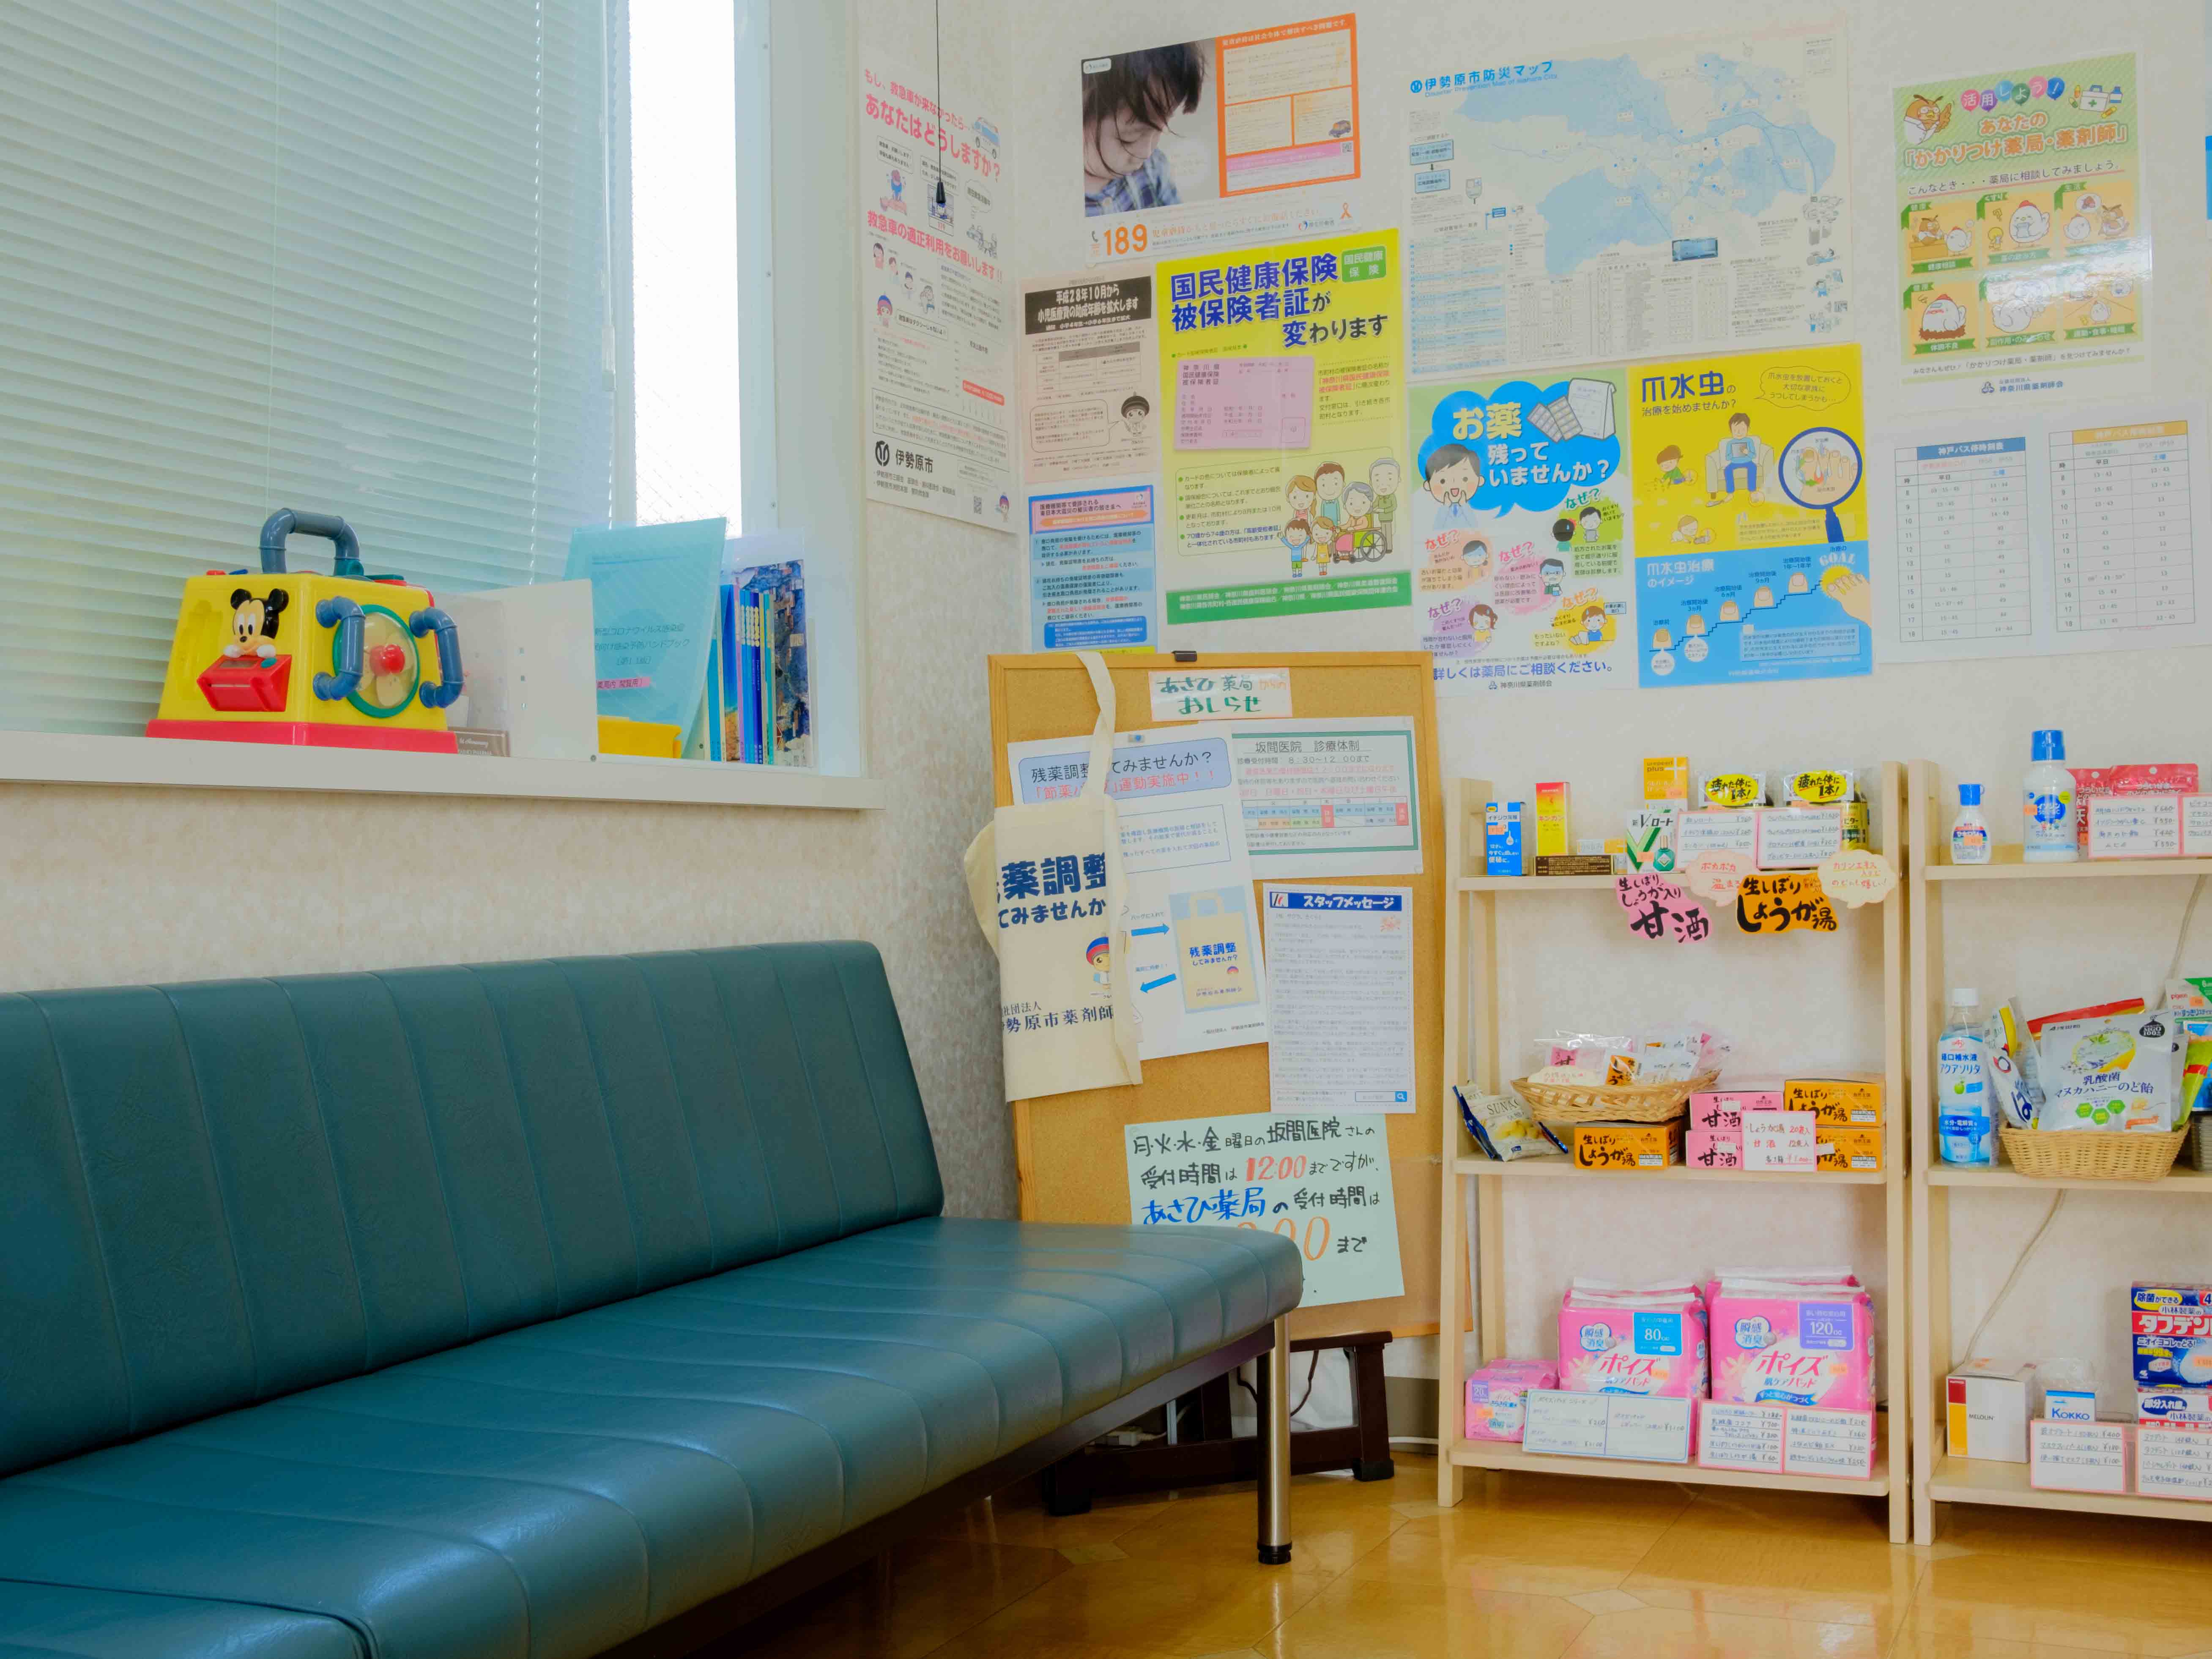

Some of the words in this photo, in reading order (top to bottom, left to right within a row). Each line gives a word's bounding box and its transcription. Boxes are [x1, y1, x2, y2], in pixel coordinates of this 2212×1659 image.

[1425, 60, 1553, 91] 伊勢原市防災マップ
[1980, 112, 2048, 135] あなたの
[1905, 123, 2127, 168] 「かかりつけ薬局・薬剤師」
[1104, 224, 1147, 256] 189
[1344, 250, 1383, 266] 国民健康
[1927, 261, 1956, 271] 健康相談
[1171, 252, 1339, 302] 国民健康保険
[1056, 284, 1120, 305] 平成28年10月から
[1172, 287, 1331, 332] 被保険者証が
[1283, 314, 1388, 348] 変わります
[1642, 370, 1736, 403] 爪水虫の
[1782, 383, 1826, 393] 大切な家族に
[1999, 381, 2064, 393] 神奈川県薬剤師会
[1642, 399, 1736, 417] 治療を始めませんか？
[1452, 401, 1522, 441] お薬
[896, 449, 933, 473] 伊勢原市
[1488, 442, 1549, 465] 残って
[1489, 460, 1610, 487] いませんか？
[1566, 488, 1599, 509] なぜ？
[1425, 529, 1459, 550] なぜ？
[1499, 541, 1533, 562] なぜ？
[1783, 556, 1812, 564] 治療開始後
[1819, 552, 1856, 567] GOAL
[1647, 559, 1715, 576] 爪水虫治療
[1748, 570, 1777, 579] 治療開始後
[1647, 575, 1695, 589] のイメージ
[1714, 584, 1743, 592] 治療開始後
[1428, 598, 1462, 619] なぜ？
[1562, 587, 1598, 610] なぜ？
[1433, 660, 1612, 681] 詳しくは薬局にご相談ください。
[1500, 680, 1552, 689] 神奈川県薬剤師会
[1178, 696, 1262, 715] おしらせ
[1255, 741, 1302, 753] 坂間医院
[1313, 739, 1360, 752] 診療体制
[1031, 752, 1212, 784] 残薬調整てみませんか？
[1711, 777, 1751, 792] 疲れた体に
[1797, 774, 1840, 792] 疲れた体に
[997, 851, 1106, 904] 薬調整
[1743, 875, 1801, 896] 生しぼり
[1303, 895, 1394, 910] スタッフメッセージ
[1630, 901, 1709, 943] 甘酒
[1737, 894, 1837, 932] しょうが湯
[1189, 942, 1237, 958] 残薬調整
[1192, 954, 1238, 966] してみませんか？
[1001, 1004, 1114, 1034] 勢原市薬剤師
[1940, 1064, 1980, 1074] アクアソリタ
[2083, 1072, 2121, 1085] 乳酸菌
[1793, 1088, 1828, 1099] 生しぼり
[2055, 1081, 2154, 1098] マヌカハニーのど飴
[1702, 1109, 1741, 1128] 甘酒
[1582, 1134, 1616, 1145] 生しぼり
[1578, 1144, 1636, 1167] しょうが湯
[1698, 1147, 1737, 1168] 甘酒
[2136, 1292, 2179, 1304] 除菌ができる
[2162, 1306, 2202, 1316] 小林製薬の
[2139, 1316, 2212, 1335] タフデン
[1598, 1352, 1661, 1375] ポイズ
[1756, 1350, 1829, 1377] ポイズ
[2169, 1412, 2211, 1422] 小林製薬の
